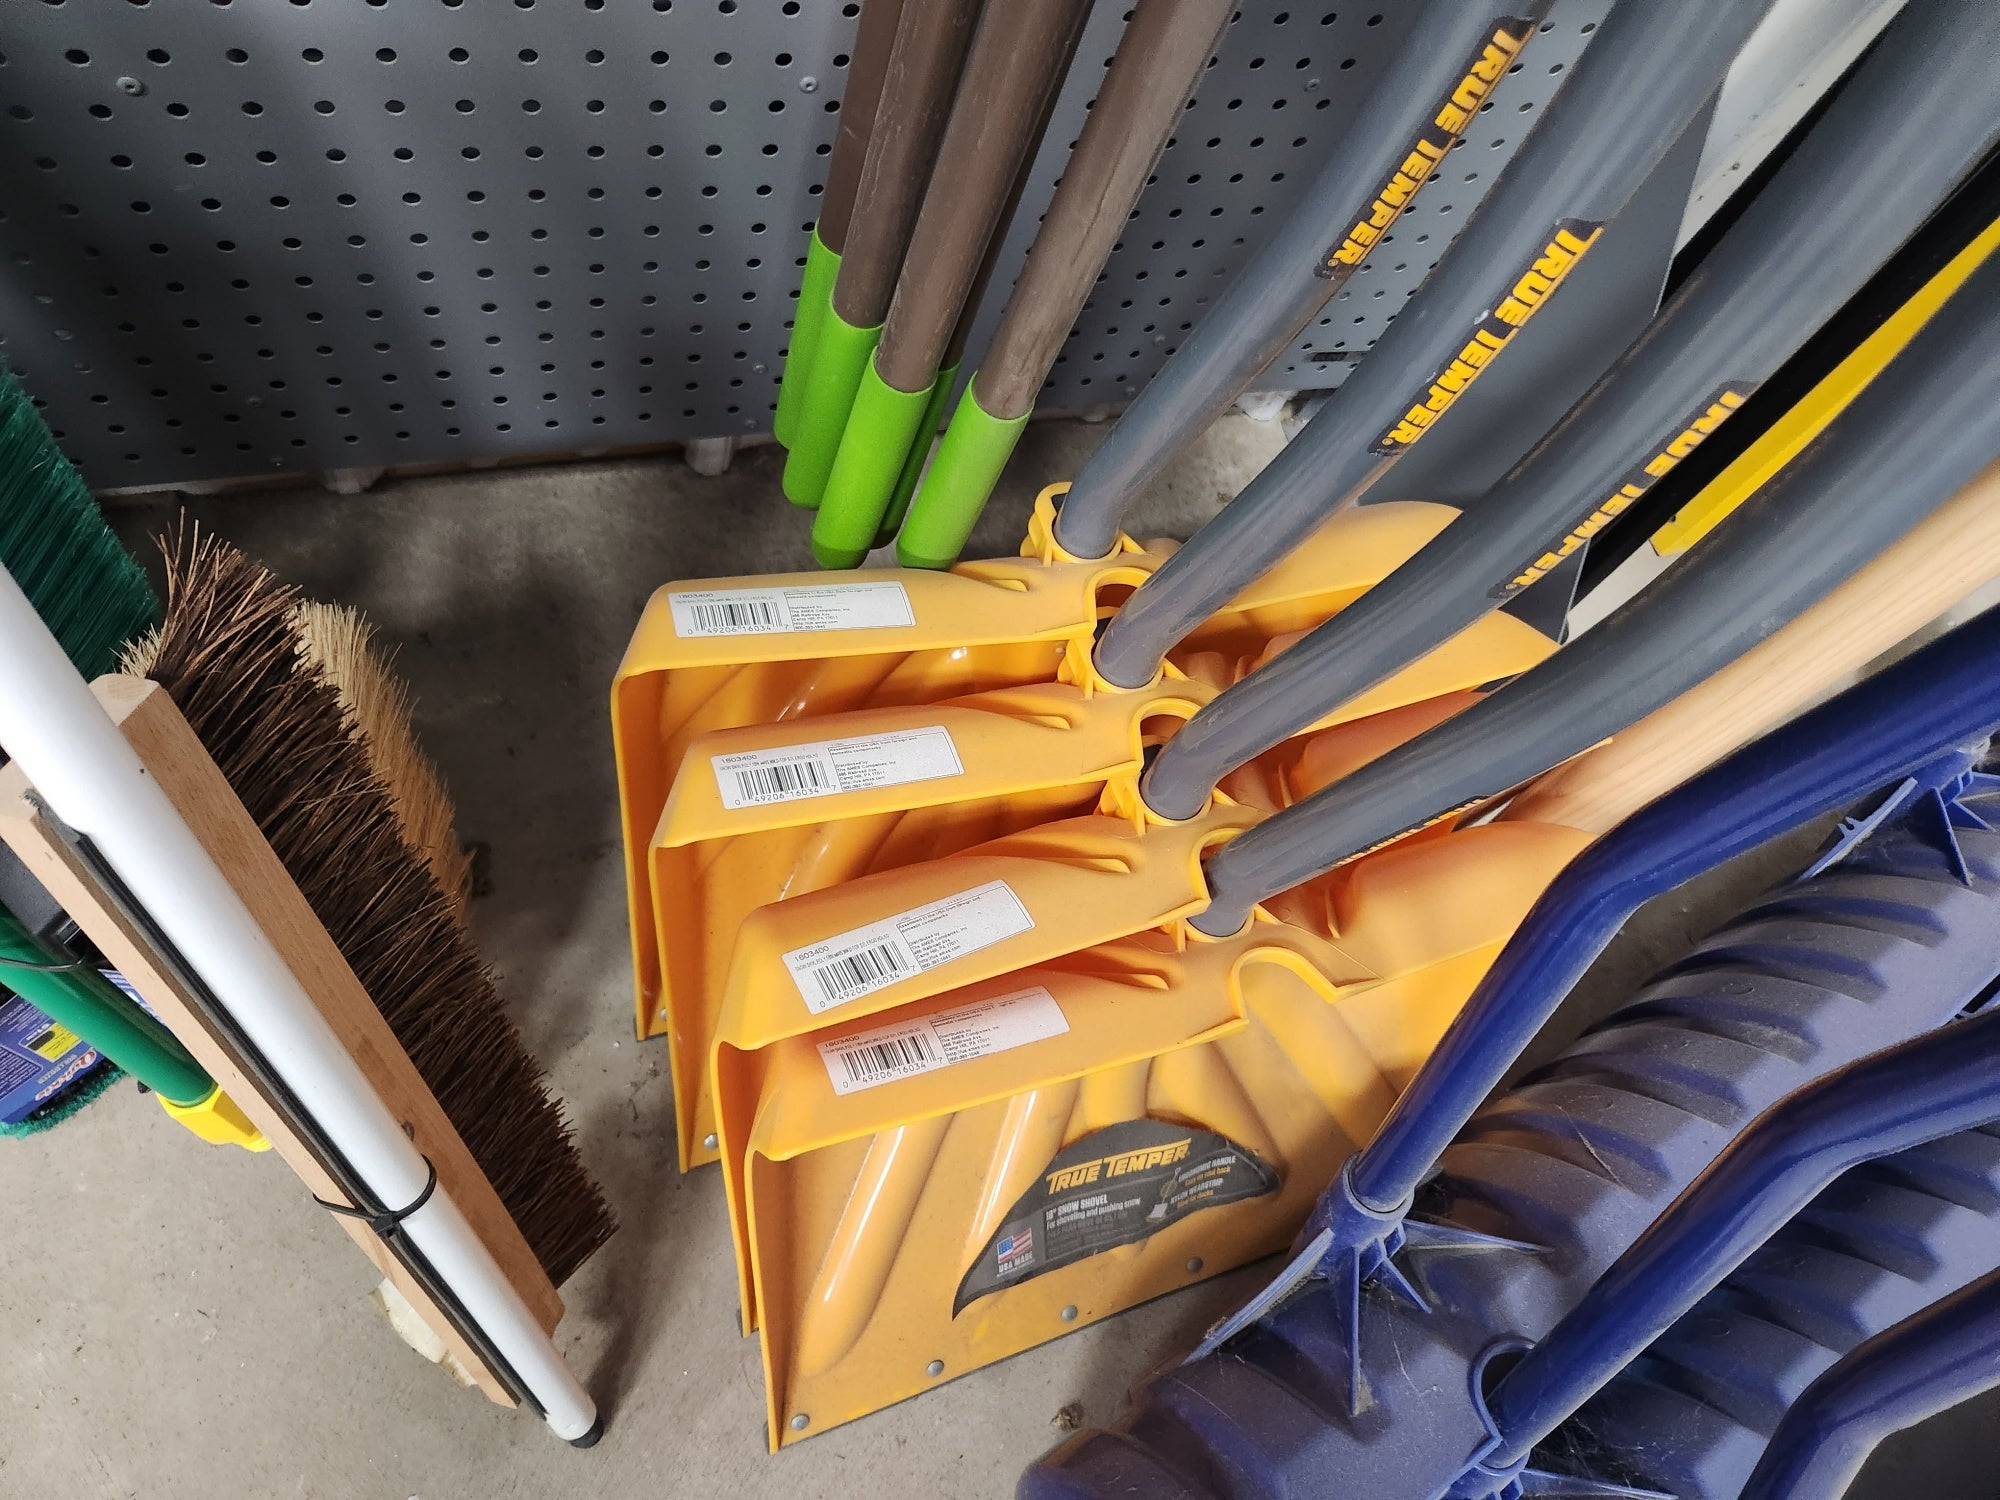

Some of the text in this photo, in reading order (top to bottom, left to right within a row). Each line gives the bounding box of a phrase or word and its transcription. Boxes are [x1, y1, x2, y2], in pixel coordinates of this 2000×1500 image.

[1333, 27, 1534, 265] TRUE TEMPER
[1387, 227, 1603, 444] TRUE TEMPER
[753, 792, 785, 802] 49206
[789, 787, 819, 797] 16034
[818, 964, 917, 1008] 0 49206 16034 7
[842, 1081, 850, 1090] 0
[861, 1069, 893, 1084] 49206
[896, 1060, 926, 1074] 16034
[936, 1055, 944, 1063] 7
[1046, 1138, 1192, 1195] TRUE TEMPER
[1057, 1200, 1079, 1216] SNOW
[1080, 1194, 1108, 1209] SHOVEL
[1086, 1208, 1098, 1217] and
[1098, 1202, 1123, 1216] pushing
[1124, 1198, 1141, 1208] snow
